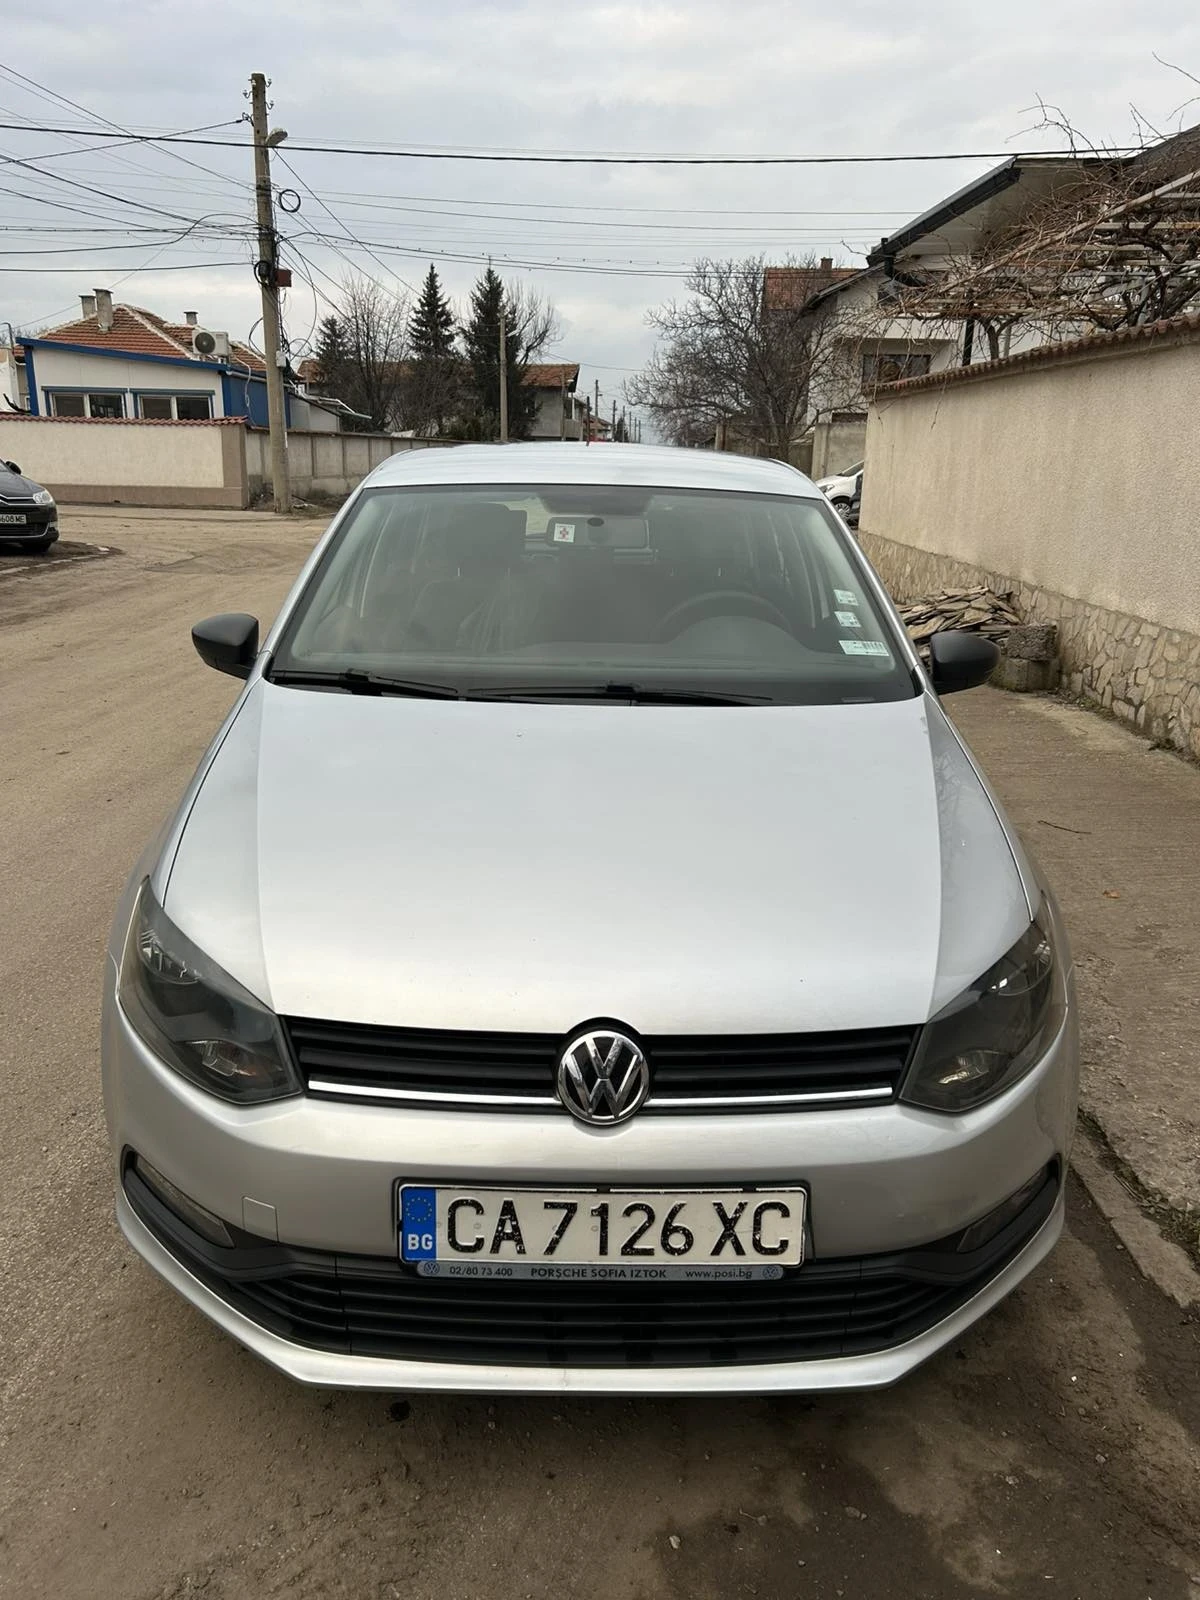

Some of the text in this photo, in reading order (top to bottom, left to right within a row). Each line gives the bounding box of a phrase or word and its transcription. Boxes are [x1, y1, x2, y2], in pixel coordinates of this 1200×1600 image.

[0, 515, 15, 523] 608
[447, 1198, 790, 1256] CA 7126 XC
[407, 1234, 433, 1250] BG
[449, 1265, 479, 1276] 02/80
[481, 1266, 493, 1276] 73
[495, 1267, 513, 1277] 400
[530, 1267, 587, 1279] PORSCHE
[590, 1268, 627, 1279] SOFIA
[630, 1268, 667, 1279] IZTOK
[685, 1268, 753, 1280] www.posi.bg
